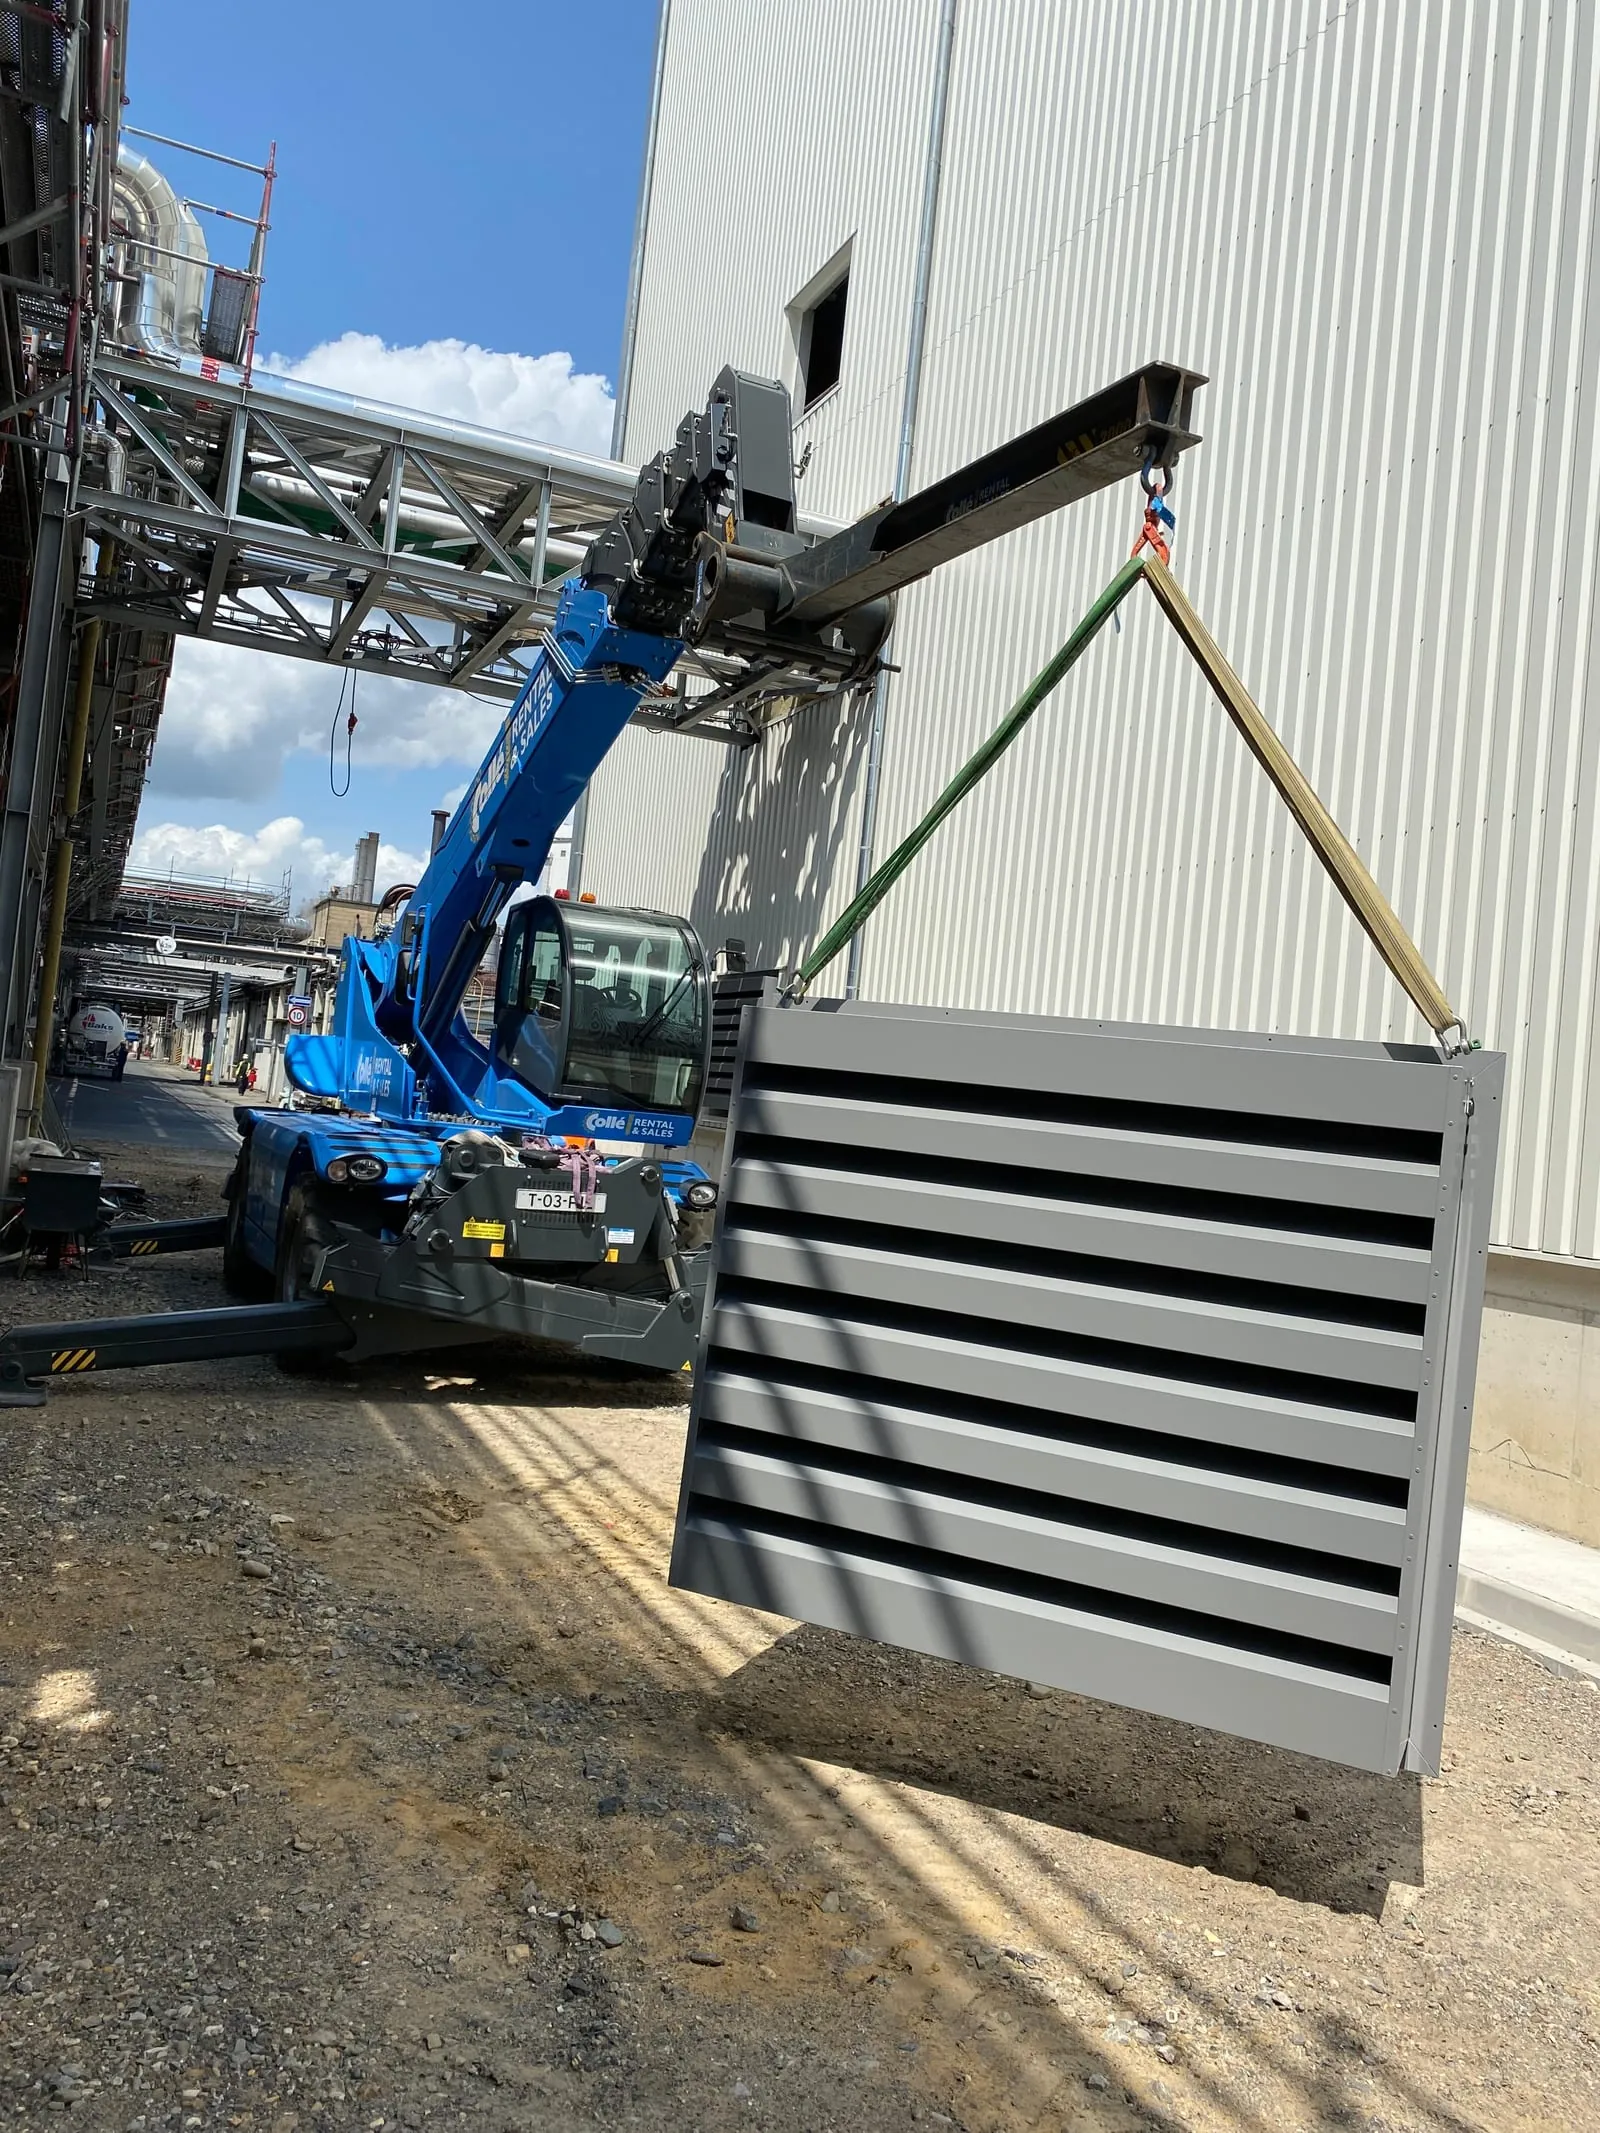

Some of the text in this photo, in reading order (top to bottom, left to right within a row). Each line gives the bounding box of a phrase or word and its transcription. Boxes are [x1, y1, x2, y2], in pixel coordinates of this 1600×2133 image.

[511, 660, 553, 743] RENTAL
[520, 683, 553, 755] SALES
[293, 1012, 302, 1020] 10
[586, 1113, 675, 1131] Collé RENTAL
[632, 1127, 674, 1138] & SALES
